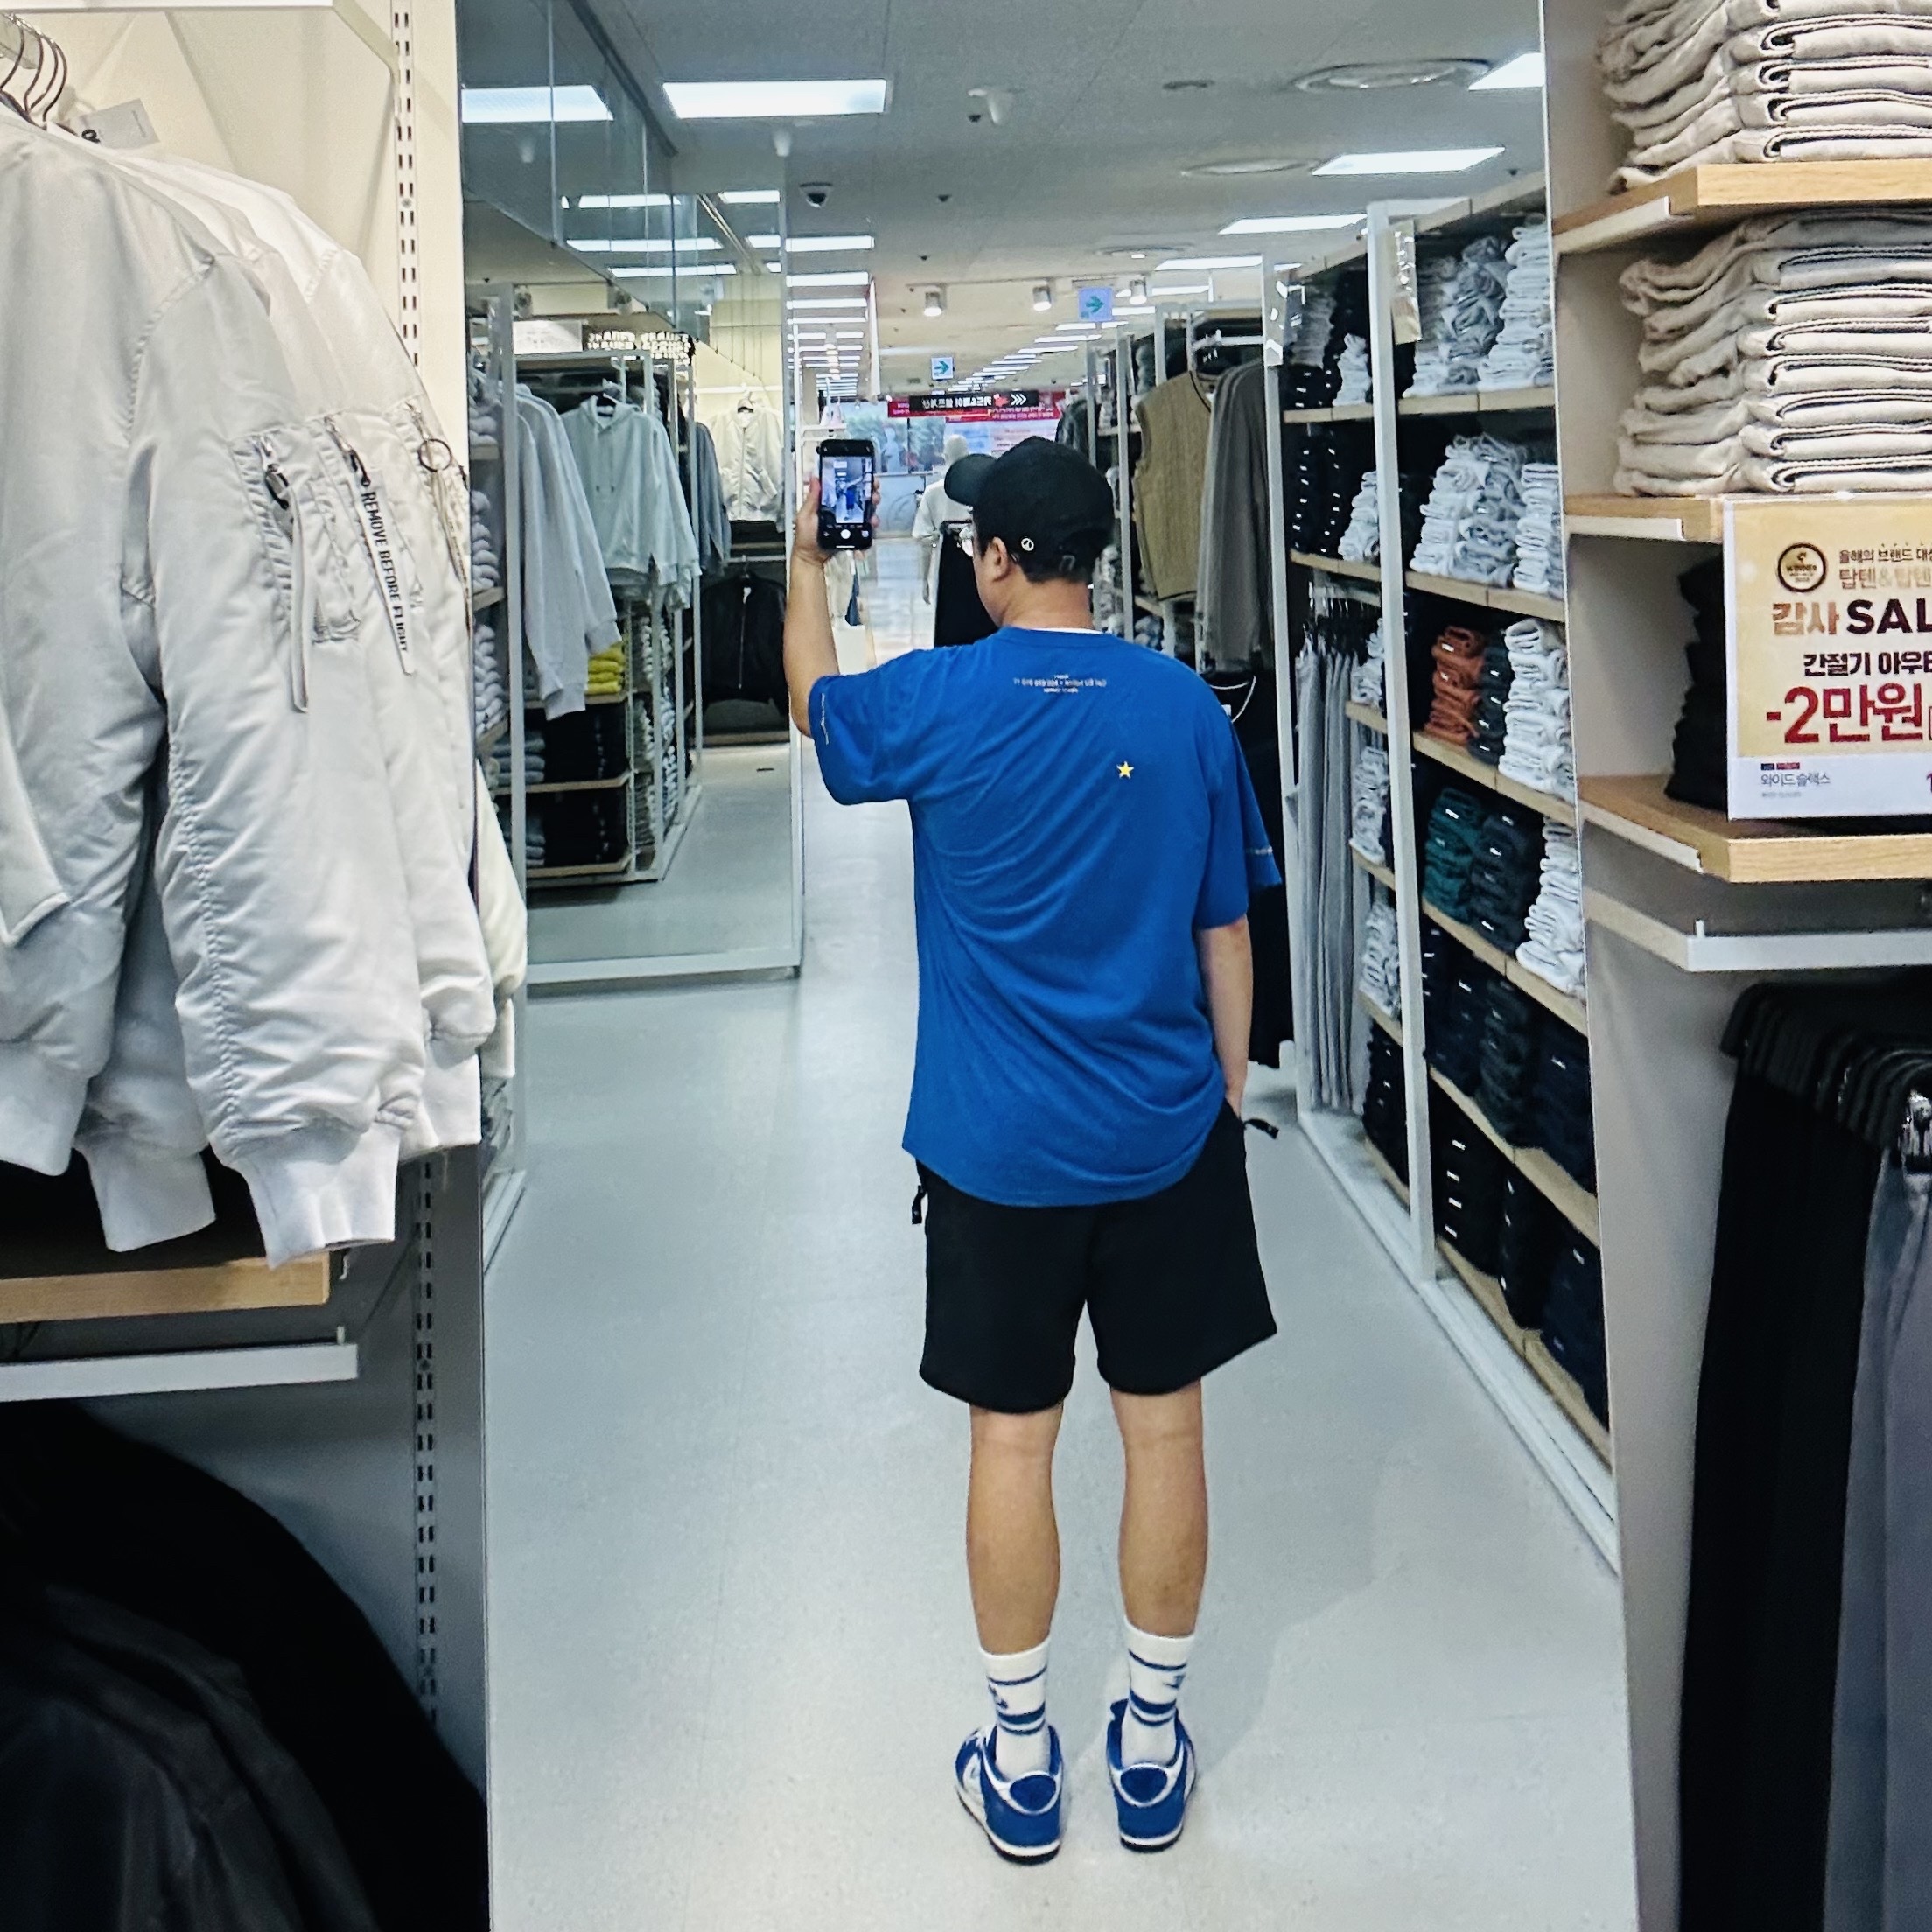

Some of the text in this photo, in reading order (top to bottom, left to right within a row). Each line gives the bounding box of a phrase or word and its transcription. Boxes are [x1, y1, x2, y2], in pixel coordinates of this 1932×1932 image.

[360, 491, 388, 548] REMOVE
[378, 550, 401, 602] BEFORE
[1878, 548, 1913, 562] 브랜드
[1916, 548, 1932, 562] 대
[1772, 602, 1839, 635] 감사
[1803, 651, 1871, 676] 간절기
[1766, 682, 1923, 744] -2만원
[1760, 774, 1796, 787] 와이드
